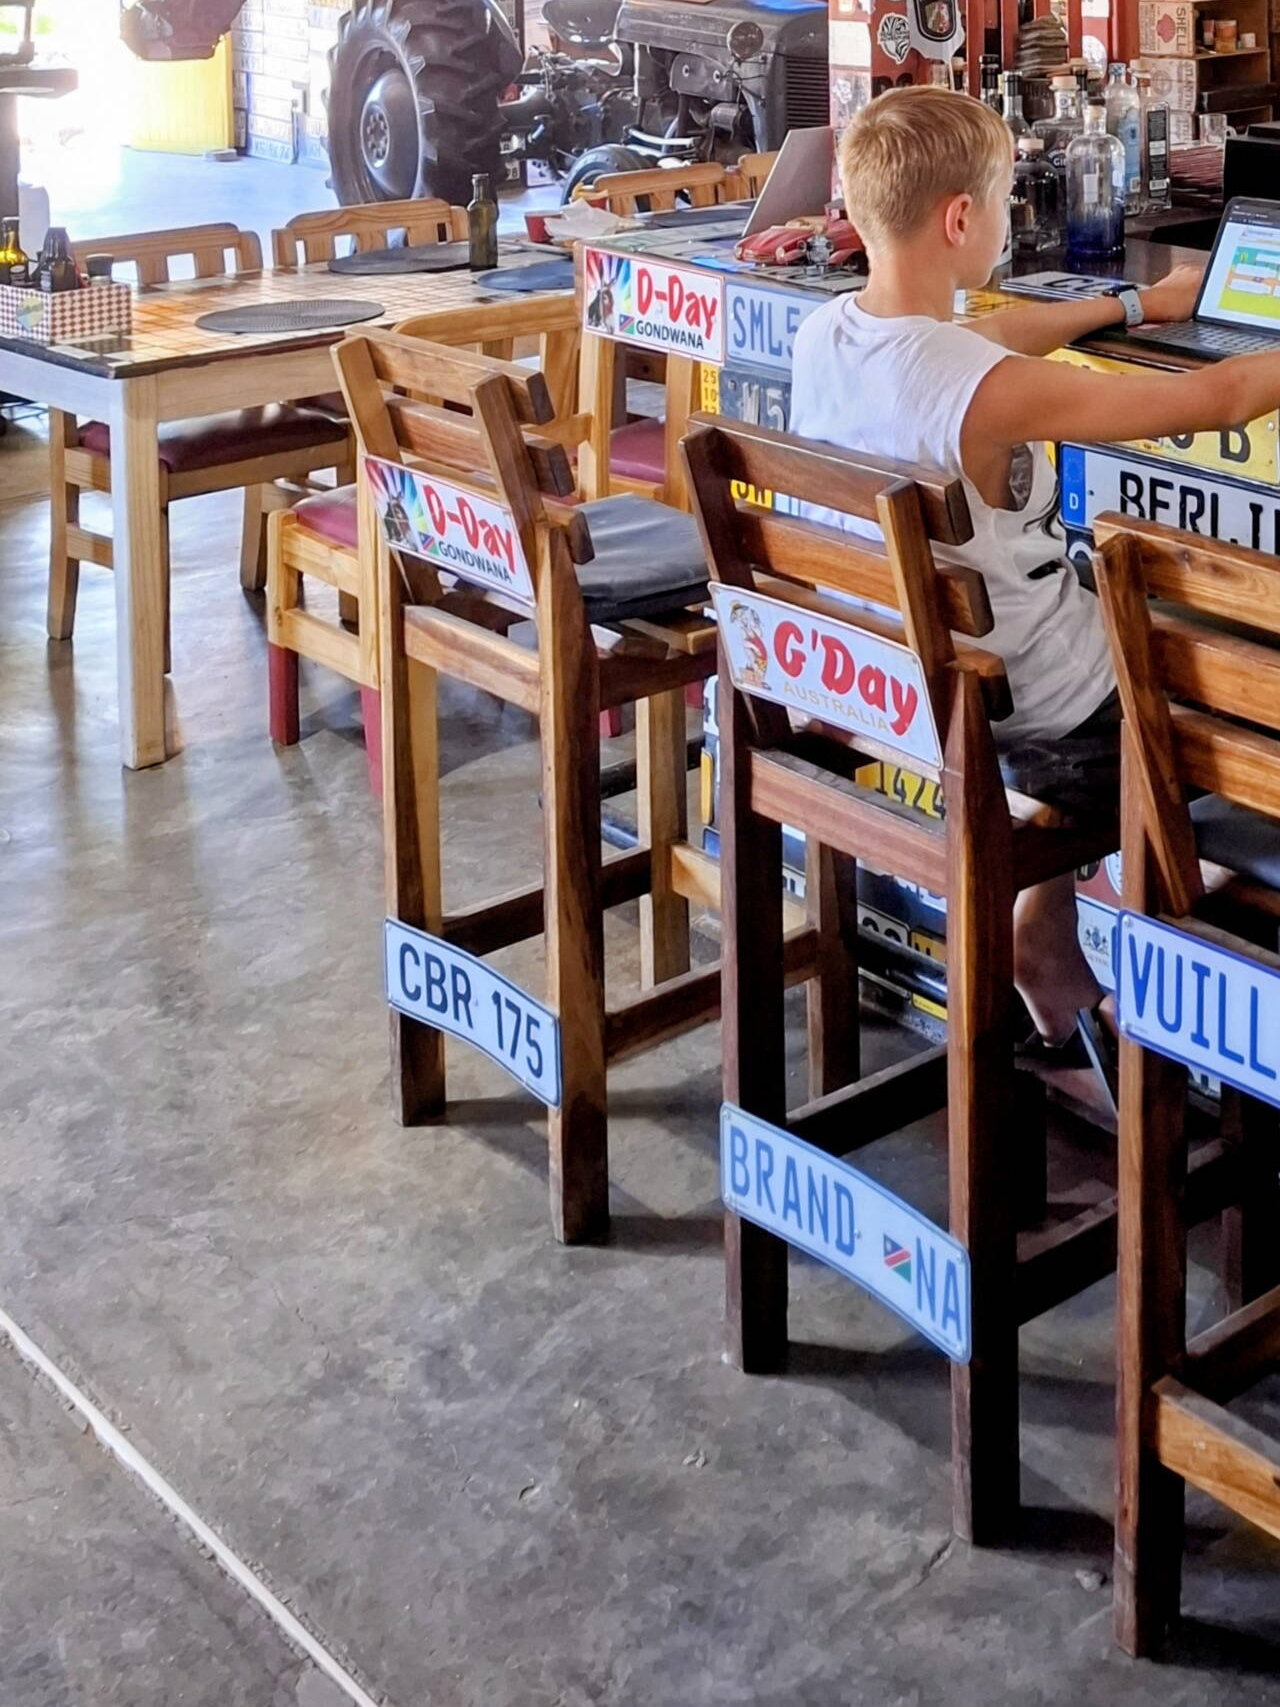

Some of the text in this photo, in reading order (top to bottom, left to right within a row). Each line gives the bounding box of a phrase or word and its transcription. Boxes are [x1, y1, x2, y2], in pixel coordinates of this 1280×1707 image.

[1176, 7, 1187, 52] SHELL
[635, 268, 718, 341] D-Day
[635, 319, 705, 350] GONDWANA
[703, 368, 717, 385] 25
[421, 483, 518, 573] D-Day
[1068, 493, 1079, 510] D
[437, 539, 513, 585] GONDWANA
[773, 620, 919, 737] G'Day
[782, 680, 890, 734] AUSTRALIA
[398, 941, 543, 1080] CBR 175
[731, 1122, 963, 1333] BRAND NA
